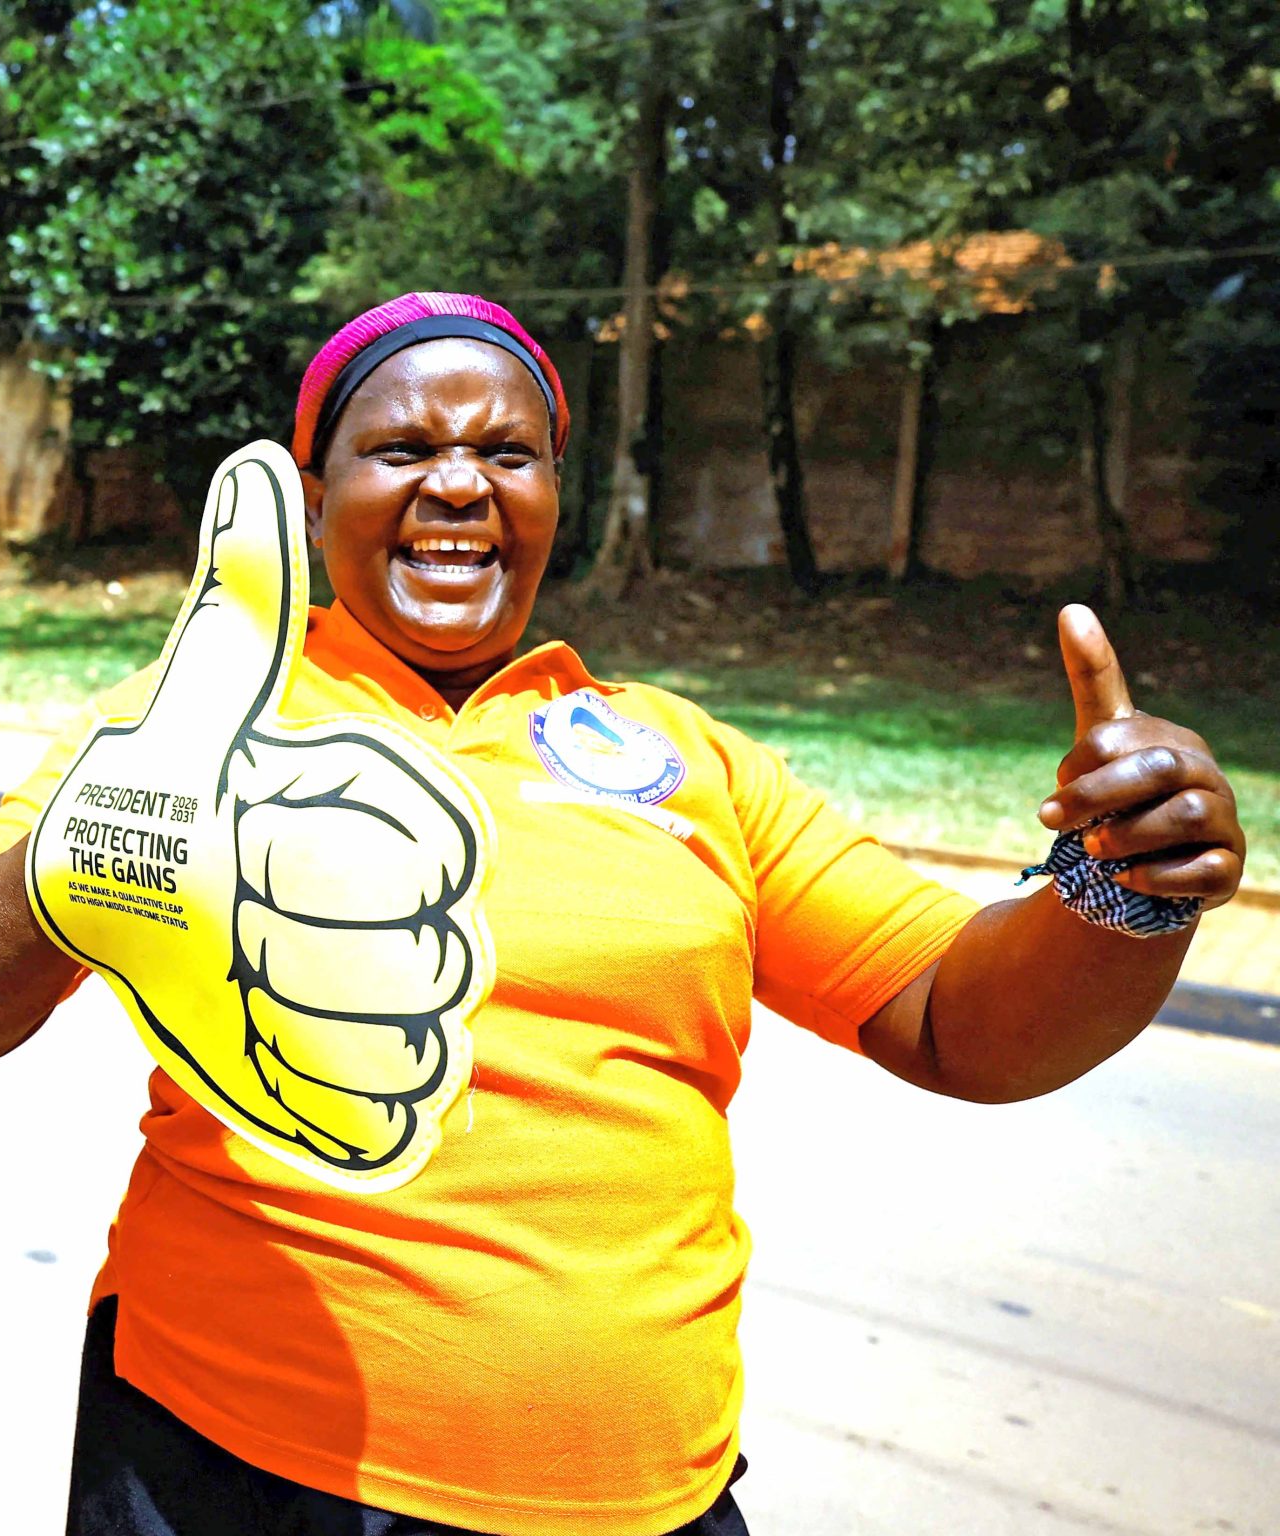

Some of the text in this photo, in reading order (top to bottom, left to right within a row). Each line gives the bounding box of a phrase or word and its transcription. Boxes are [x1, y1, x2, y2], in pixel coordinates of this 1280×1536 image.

[75, 783, 171, 818] PRESIDENT
[170, 809, 195, 824] 2031
[172, 795, 198, 810] 2026
[64, 816, 188, 865] PROTECTING
[69, 846, 177, 894] THE GAINS
[68, 881, 183, 915] AS WE MAKE A QUALITATIVE LEAP
[69, 894, 189, 931] INTO HIGH MIDDLE INCOME STATUS
